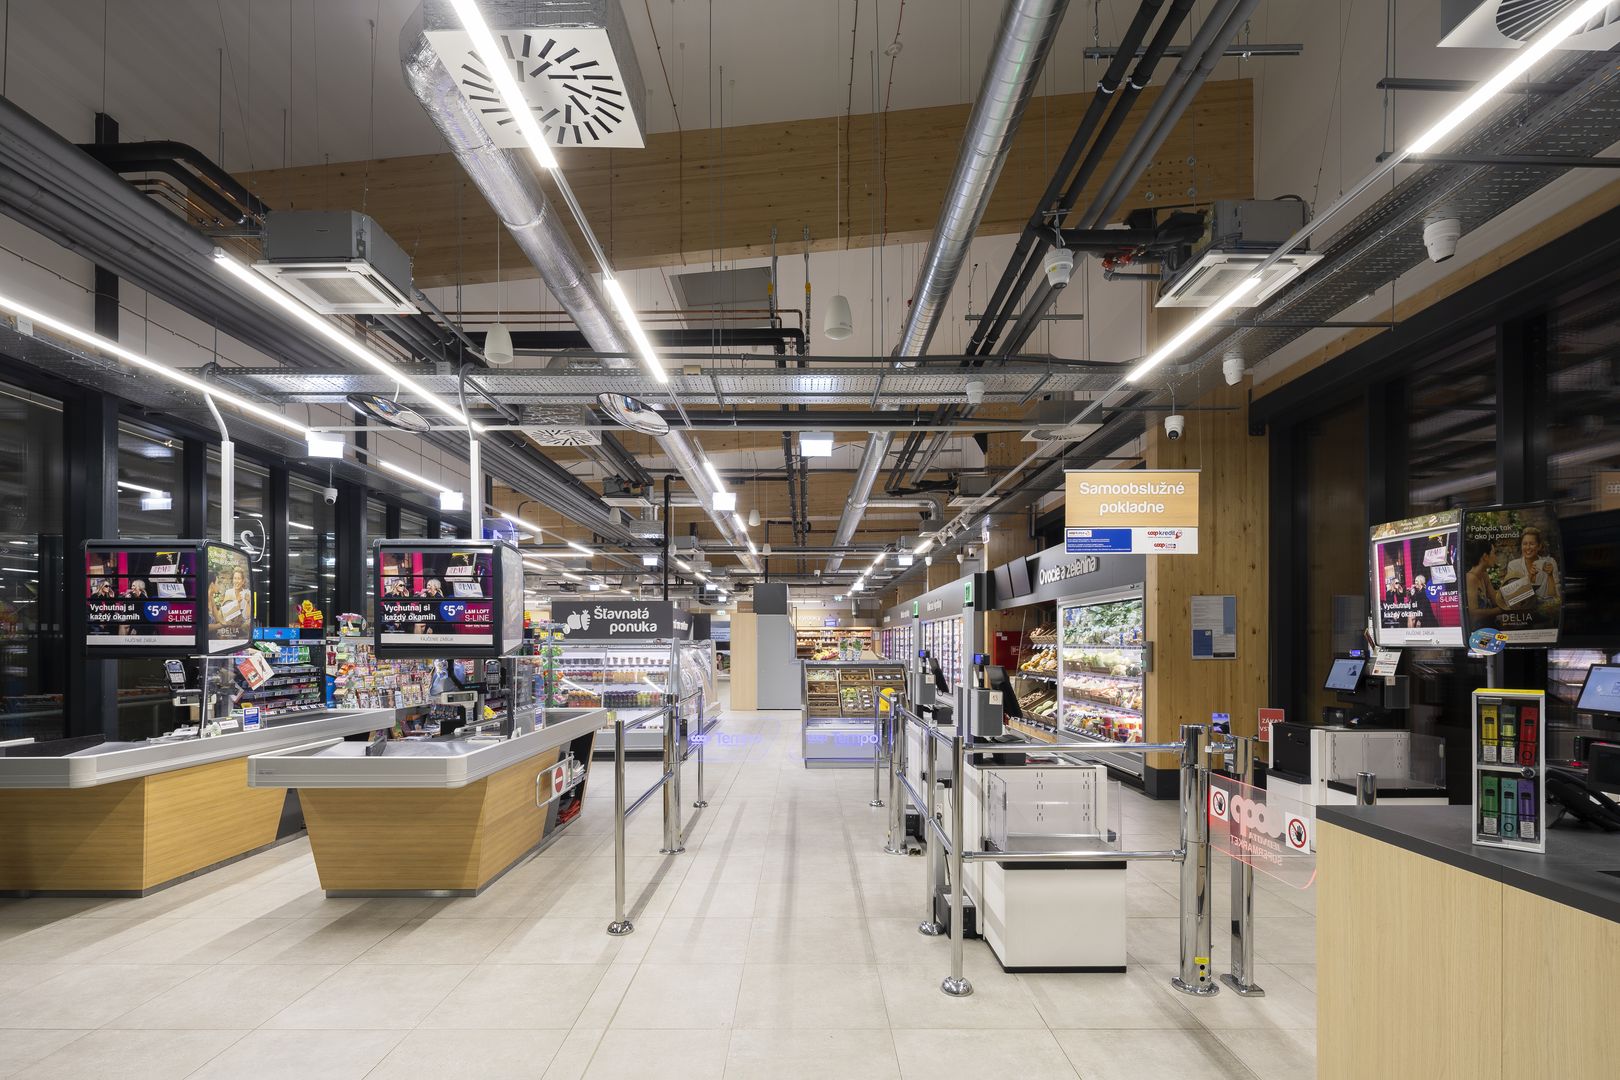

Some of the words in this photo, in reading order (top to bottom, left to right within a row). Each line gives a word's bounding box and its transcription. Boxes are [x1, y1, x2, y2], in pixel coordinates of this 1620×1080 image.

[1079, 481, 1185, 495] Samoobslužné
[1099, 501, 1165, 516] pokladne
[1039, 565, 1060, 585] Ovocie
[1066, 555, 1096, 578] zelenina
[90, 603, 126, 612] Vychutnaj
[127, 603, 135, 611] si
[384, 604, 421, 612] Vychutnaj
[1383, 602, 1411, 610] Vychutnaj
[89, 613, 111, 621] každý
[384, 613, 407, 622] každý
[408, 613, 436, 621] okamih
[593, 605, 650, 620] Šťavnatá
[1383, 611, 1400, 619] každý
[1401, 610, 1423, 618] okamih
[1502, 612, 1533, 623] DELIA
[609, 621, 658, 635] ponuka
[832, 732, 879, 747] Tempo
